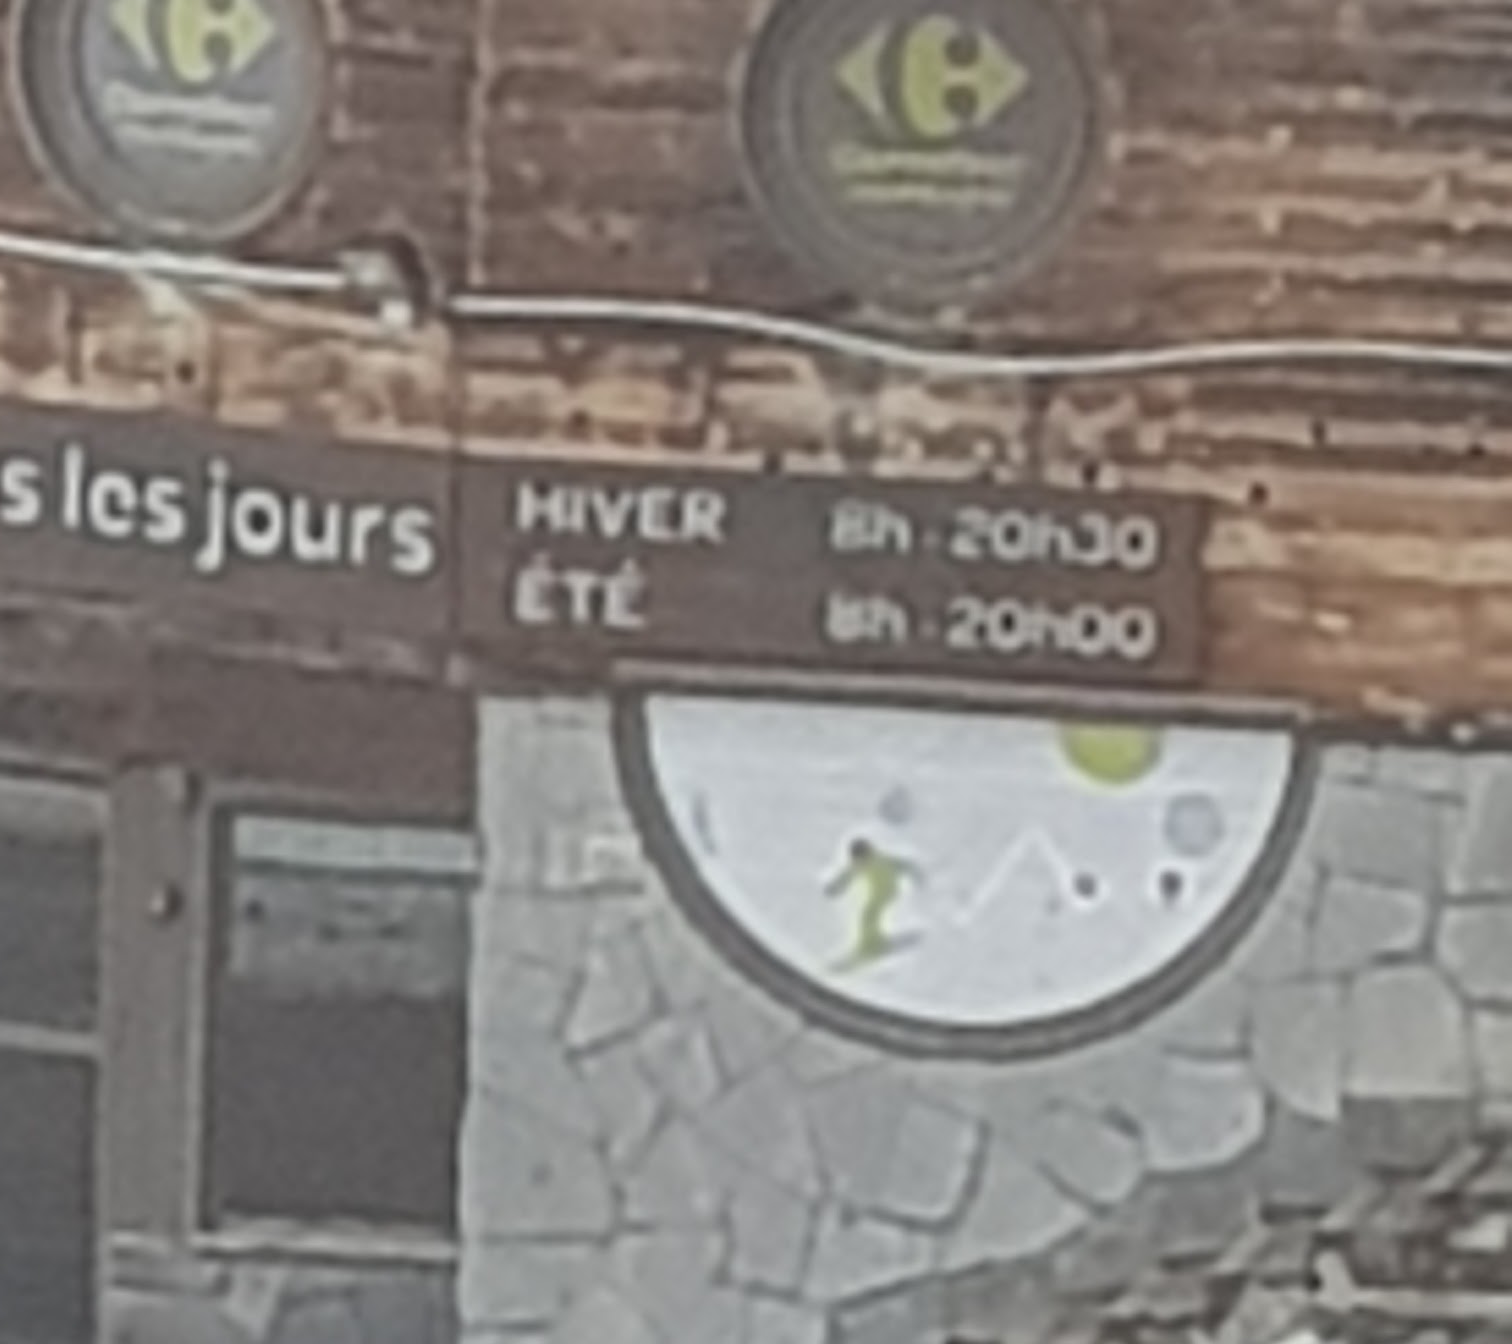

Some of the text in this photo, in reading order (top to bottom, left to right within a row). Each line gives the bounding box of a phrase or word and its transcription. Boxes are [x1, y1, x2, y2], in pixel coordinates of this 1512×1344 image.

[61, 441, 186, 544] les
[194, 458, 435, 574] jours
[515, 481, 726, 544] HIVER
[950, 506, 1160, 570] 20h30
[514, 552, 648, 630] ÉTÉ
[946, 596, 1159, 660] 20h00
